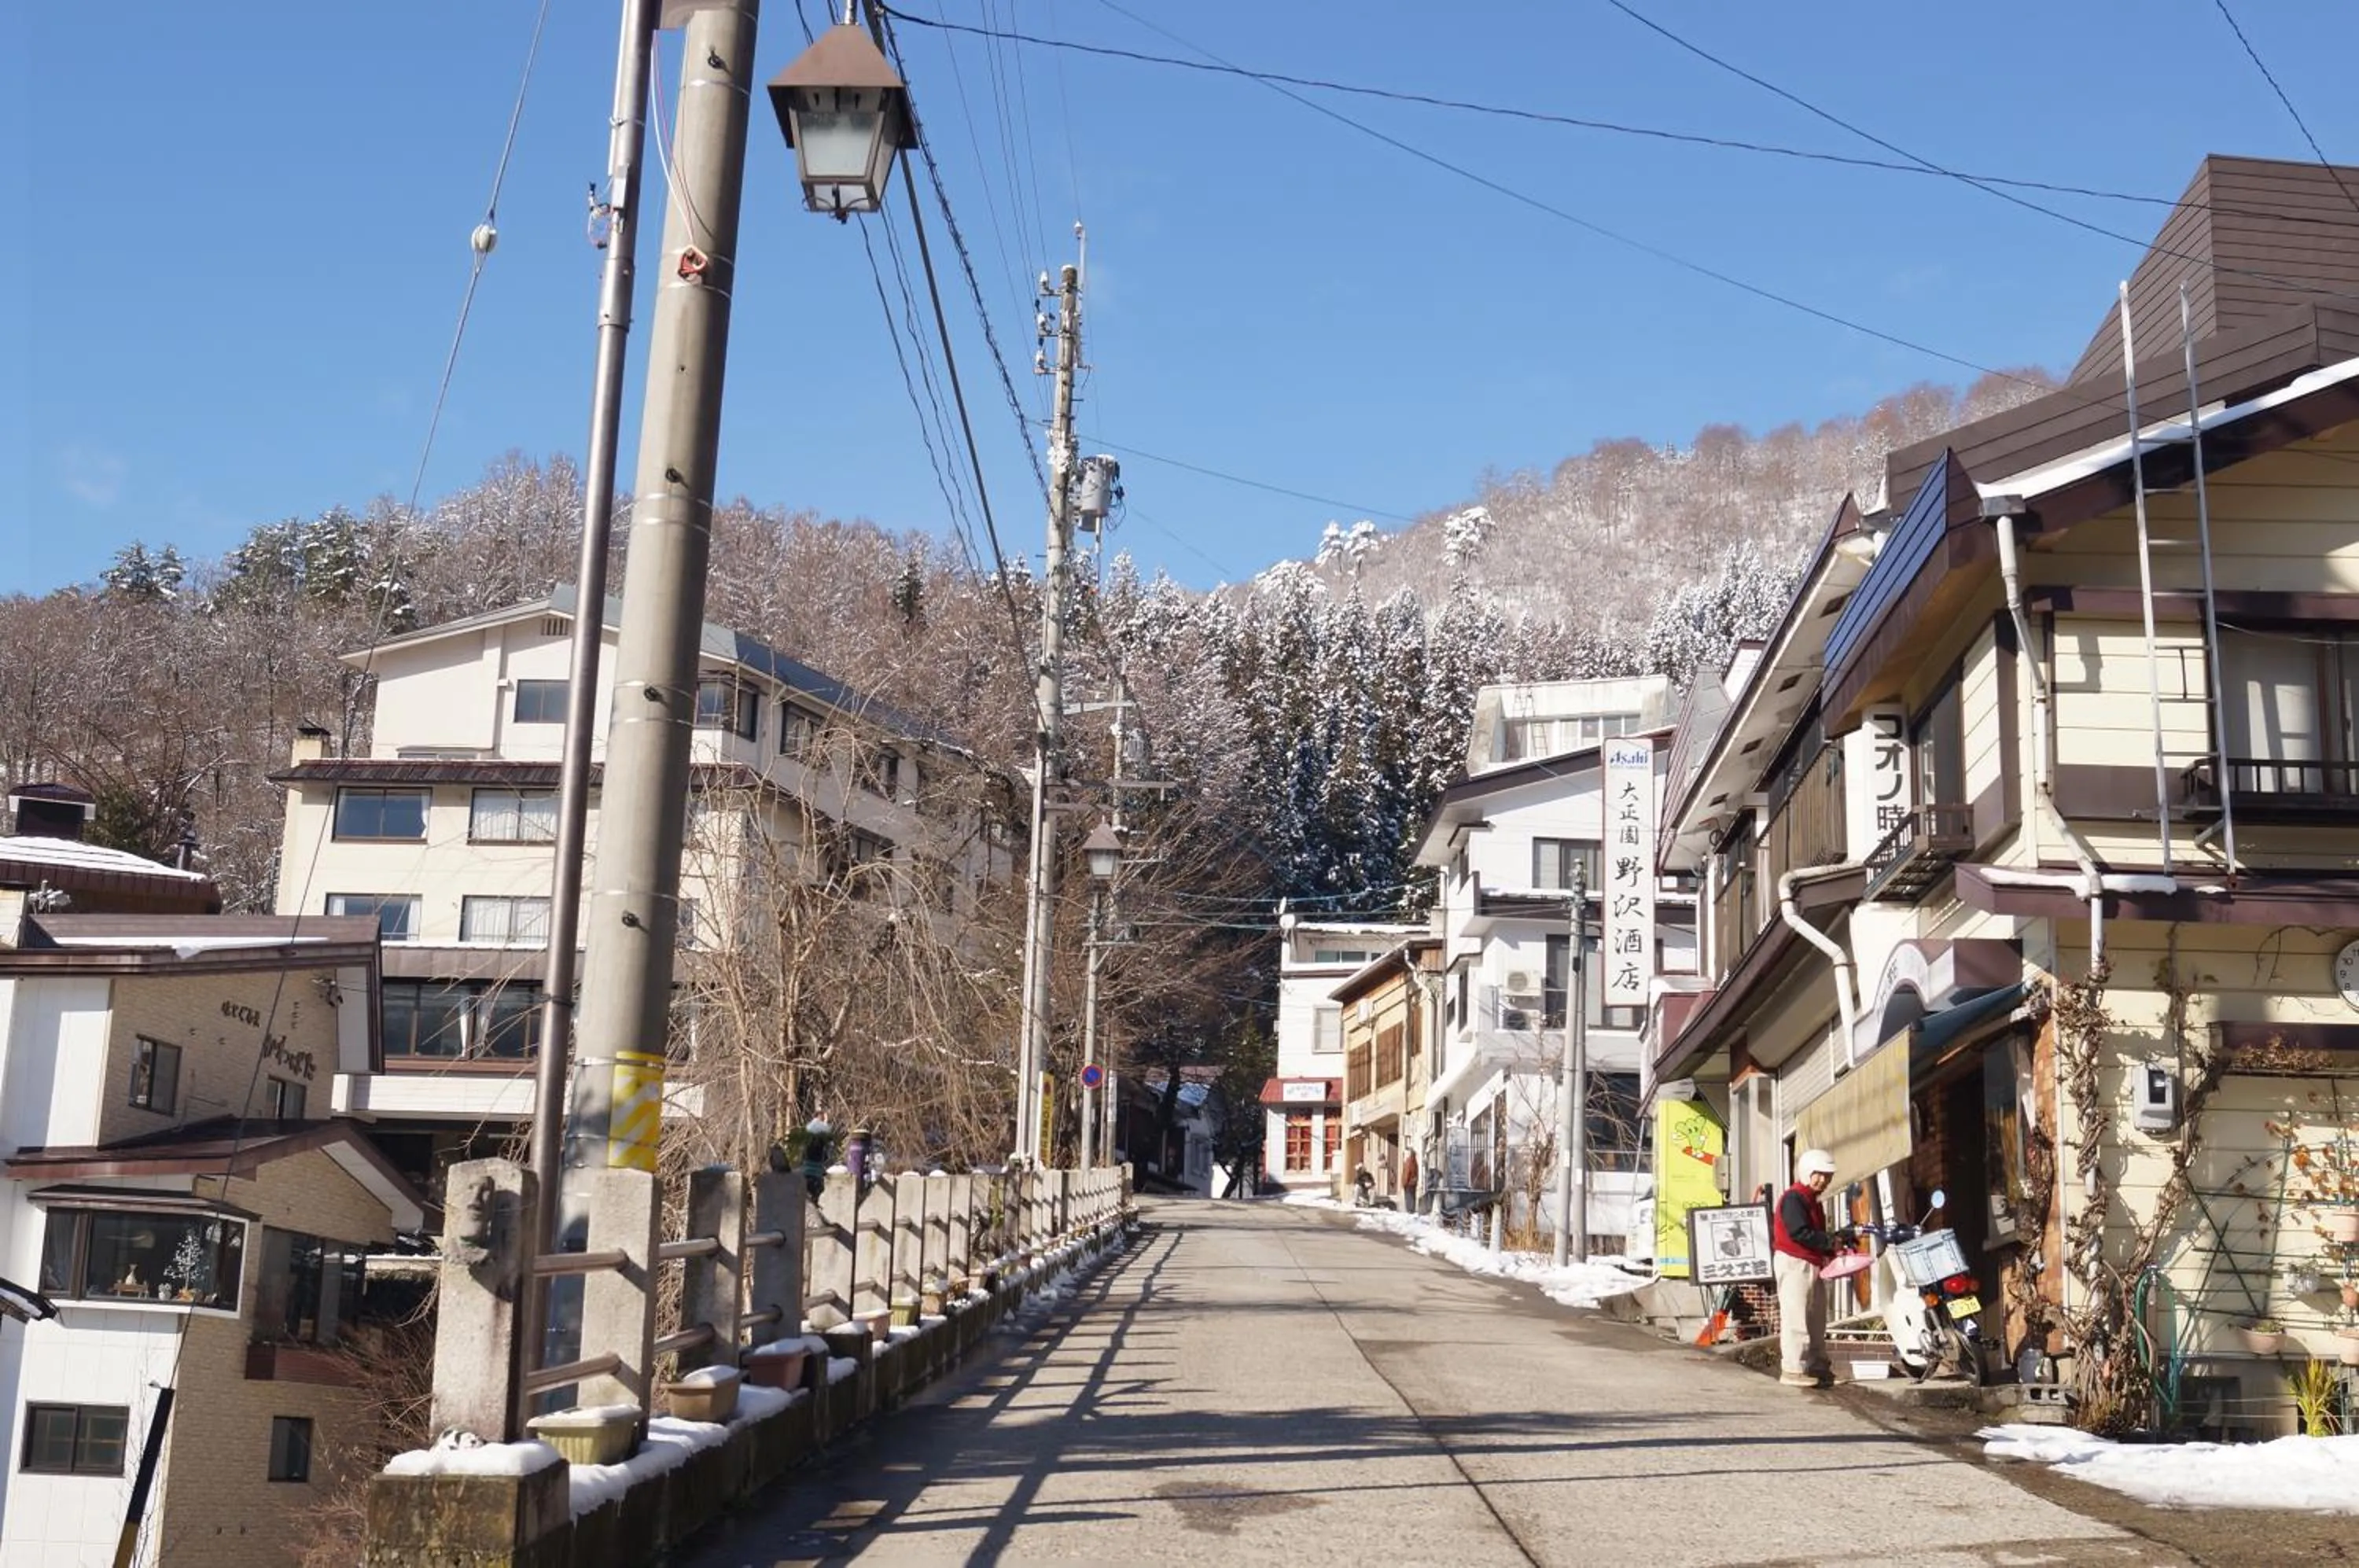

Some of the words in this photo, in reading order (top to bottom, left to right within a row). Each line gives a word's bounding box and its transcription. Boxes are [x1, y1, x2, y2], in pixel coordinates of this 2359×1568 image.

[1610, 751, 1649, 764] Asahi
[1874, 714, 1904, 862] コオノ時
